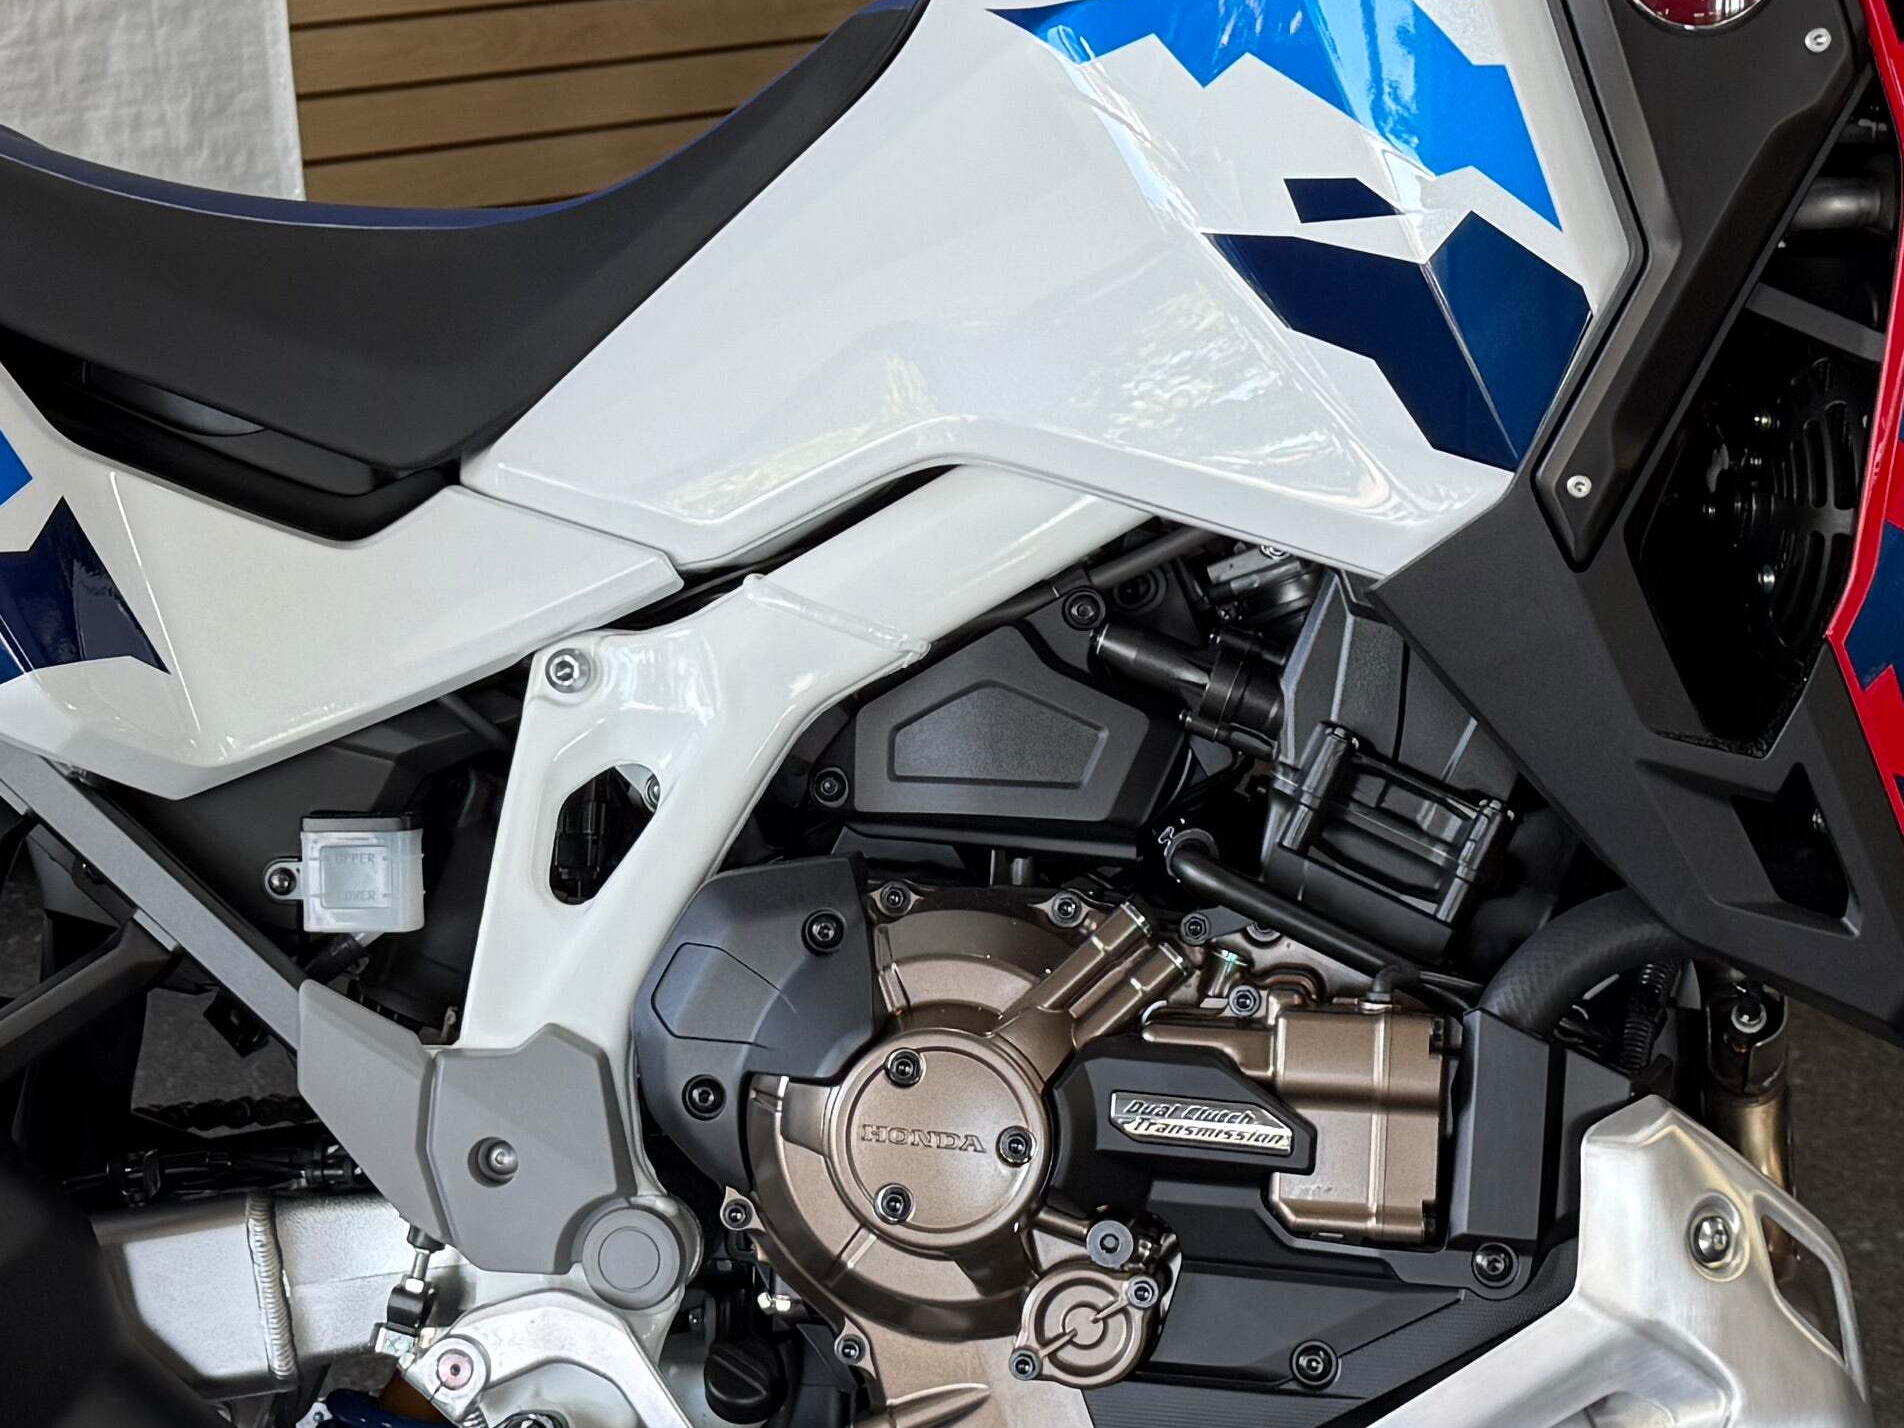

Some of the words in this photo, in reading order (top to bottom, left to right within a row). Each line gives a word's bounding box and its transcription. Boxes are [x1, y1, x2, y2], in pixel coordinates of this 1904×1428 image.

[1123, 1099, 1181, 1118] Dual
[1181, 1105, 1256, 1125] Clutch
[859, 1123, 987, 1153] HONDA
[1133, 1116, 1287, 1146] Transmission
